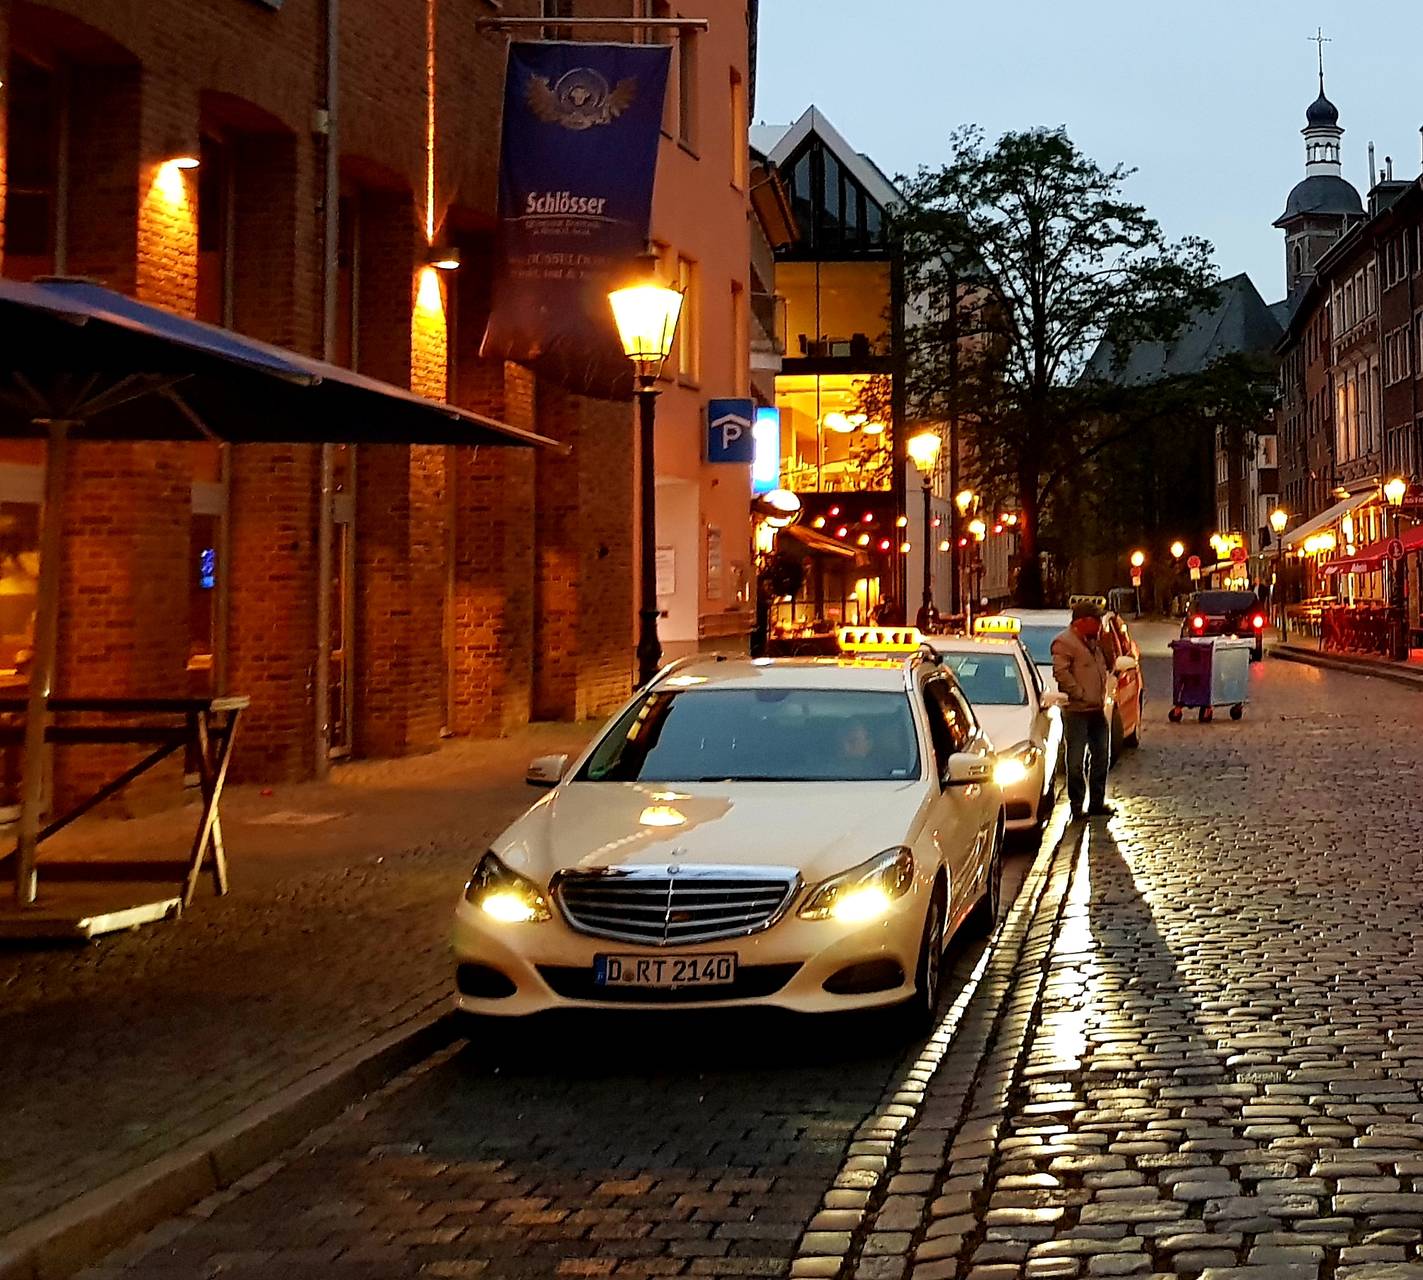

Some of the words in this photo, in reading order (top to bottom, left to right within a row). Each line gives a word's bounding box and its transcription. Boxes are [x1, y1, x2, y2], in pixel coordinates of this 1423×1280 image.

[526, 191, 606, 214] Schlösser
[723, 424, 742, 449] P
[847, 631, 908, 645] TAXI
[608, 960, 622, 981] D
[637, 960, 666, 982] RT
[672, 958, 731, 981] 2140
